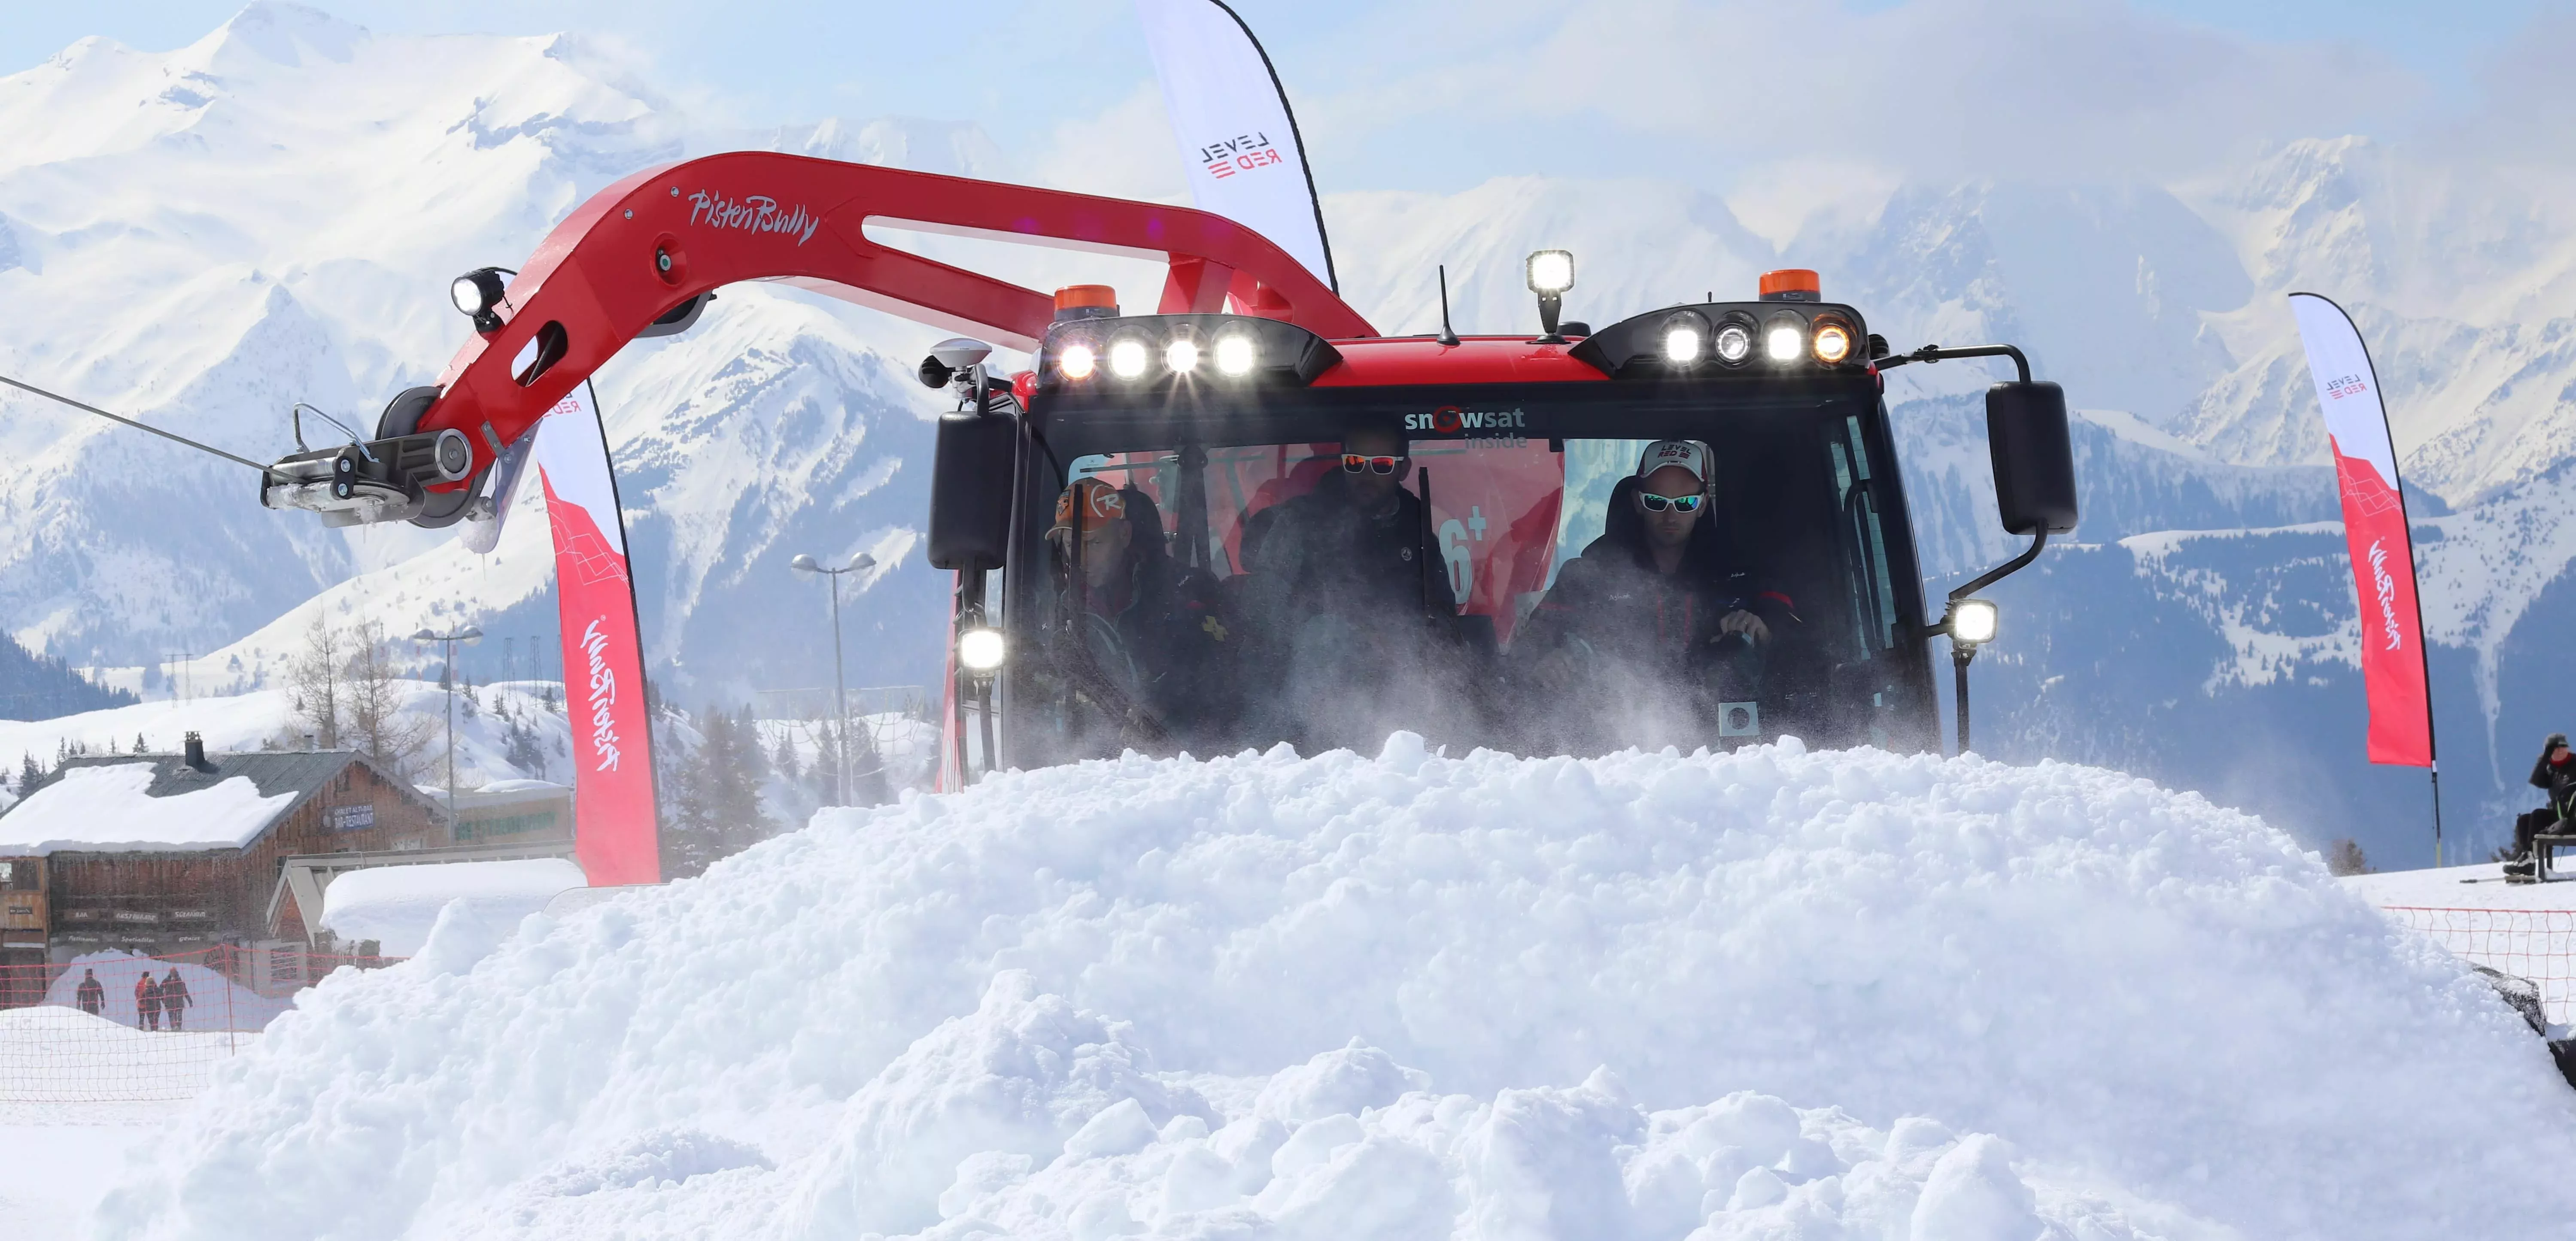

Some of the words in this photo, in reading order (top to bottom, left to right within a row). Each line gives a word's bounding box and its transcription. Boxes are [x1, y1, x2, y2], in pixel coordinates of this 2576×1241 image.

[688, 189, 819, 247] PistenBully
[1404, 406, 1525, 434] snowsat
[1464, 433, 1527, 449] inside
[1661, 444, 1691, 454] LEVEL
